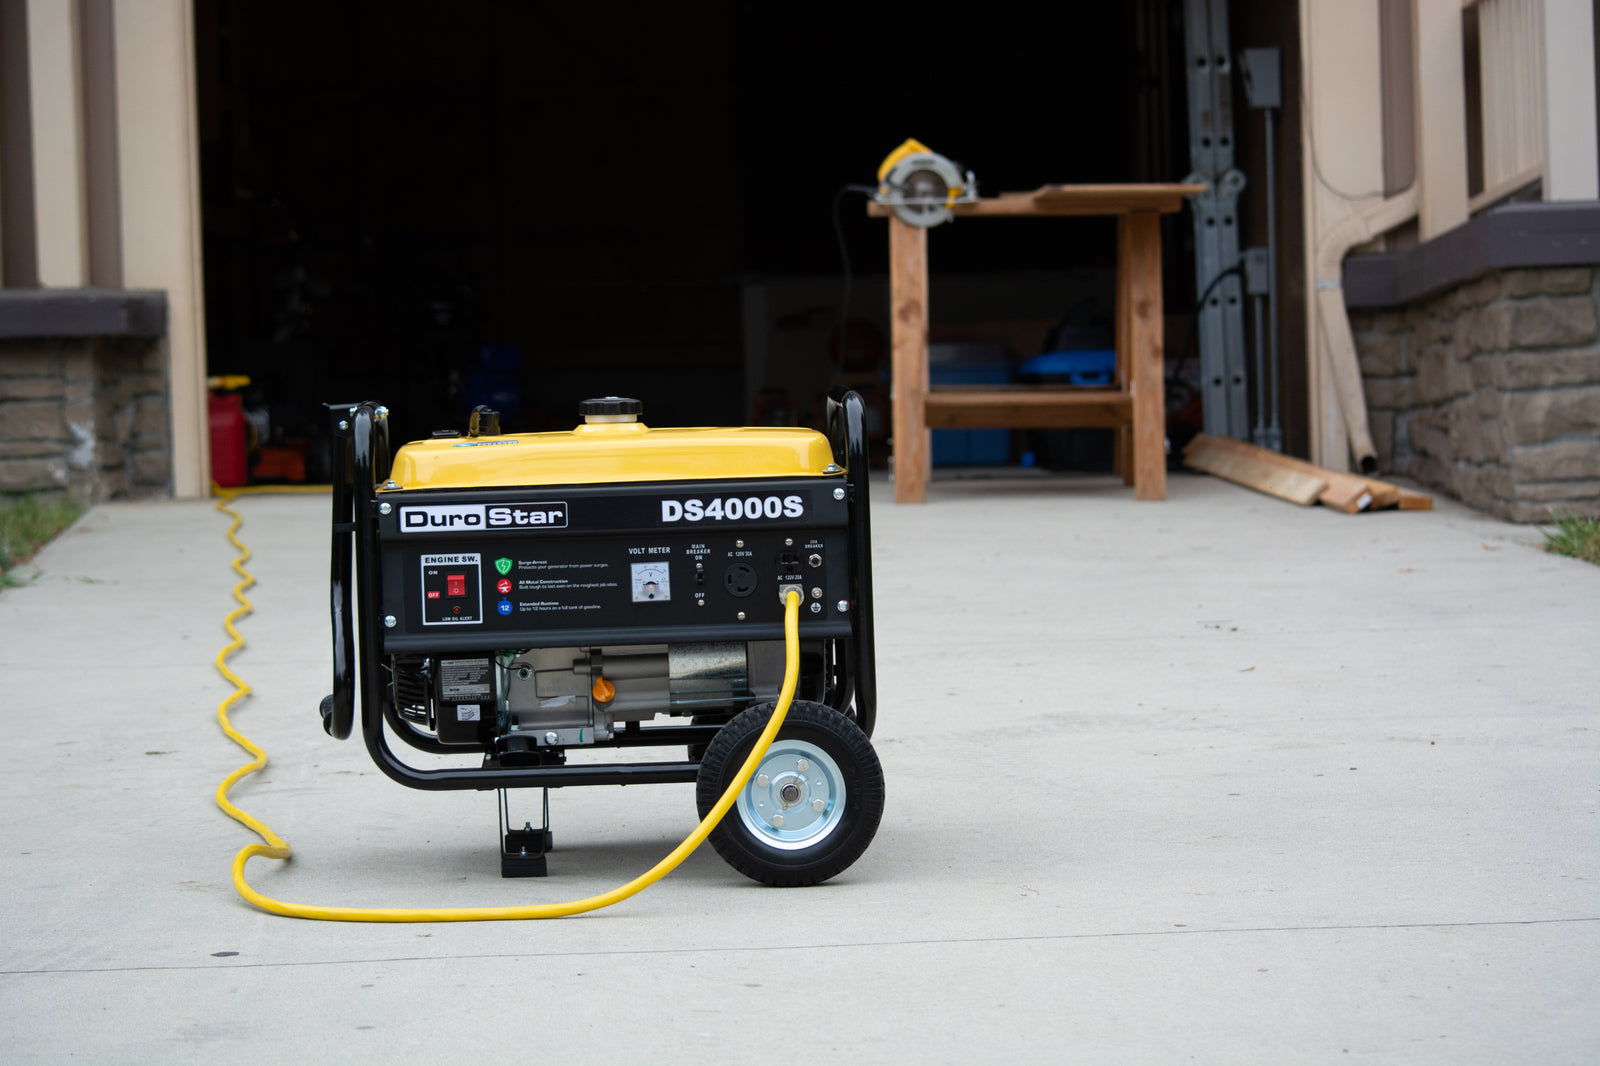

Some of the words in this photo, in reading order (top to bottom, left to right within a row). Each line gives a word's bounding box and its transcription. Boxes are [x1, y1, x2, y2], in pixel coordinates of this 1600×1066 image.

[662, 496, 804, 522] DS4000S
[425, 556, 460, 564] ENGINE
[501, 604, 510, 612] 12
